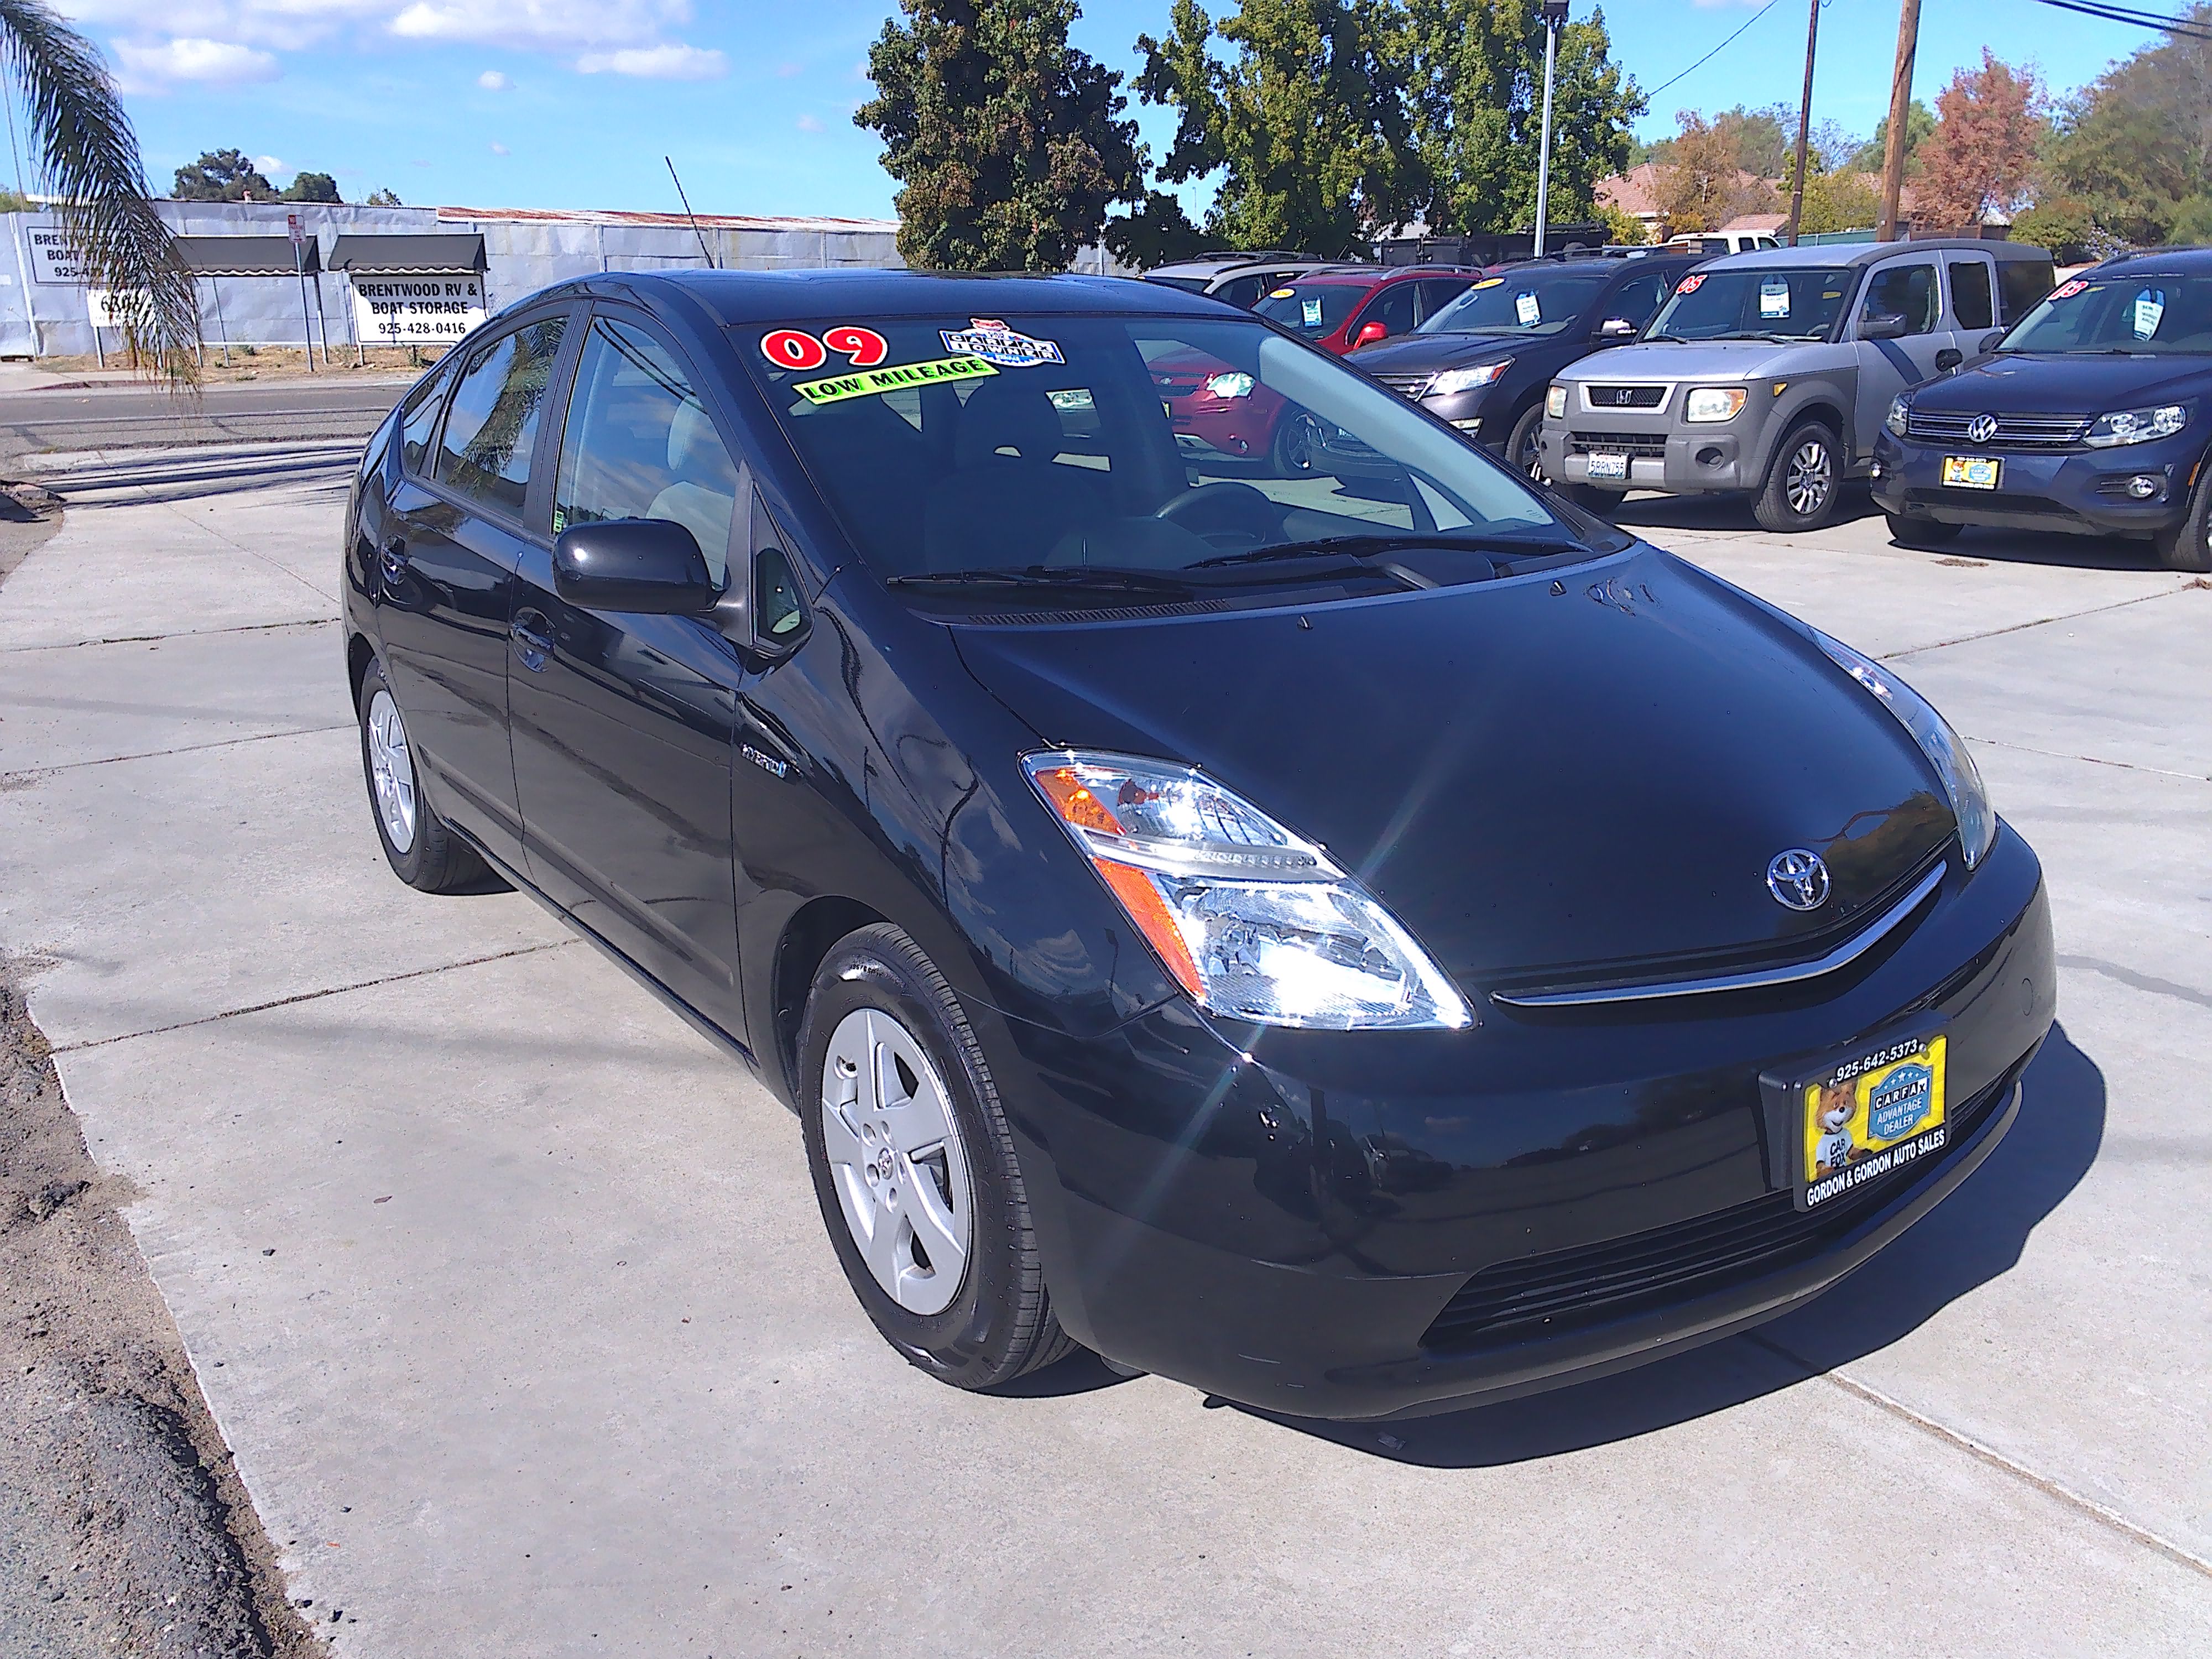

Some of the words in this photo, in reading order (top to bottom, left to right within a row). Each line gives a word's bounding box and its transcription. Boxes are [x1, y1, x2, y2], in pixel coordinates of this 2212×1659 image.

[48, 251, 79, 260] BOAT
[359, 284, 440, 296] BRENTWOOD
[445, 284, 461, 296] RV
[467, 283, 477, 296] &
[1676, 275, 1708, 294] 05
[372, 302, 404, 314] BOAT
[410, 301, 468, 314] STORAGE
[379, 323, 466, 333] 925-428-0416
[760, 326, 888, 370] 09
[950, 334, 1050, 351] CARFAX
[972, 344, 1055, 359] OWNER
[804, 378, 860, 399] LOW
[871, 358, 985, 387] MILEAGE
[1591, 461, 1624, 474] 5RRN755
[1837, 1039, 1918, 1082] 925-642-5373
[1875, 1083, 1926, 1109] CARFAX
[1877, 1097, 1922, 1125] ADVANTAGE
[1884, 1114, 1913, 1135] DEALER
[1830, 1138, 1845, 1156] CAR
[1831, 1150, 1846, 1167] FOX
[1807, 1175, 1845, 1207] GORDON
[1846, 1170, 1853, 1188] &
[1854, 1154, 1891, 1184] GORDON
[1893, 1141, 1917, 1167] AUTO
[1918, 1129, 1945, 1155] SALES
